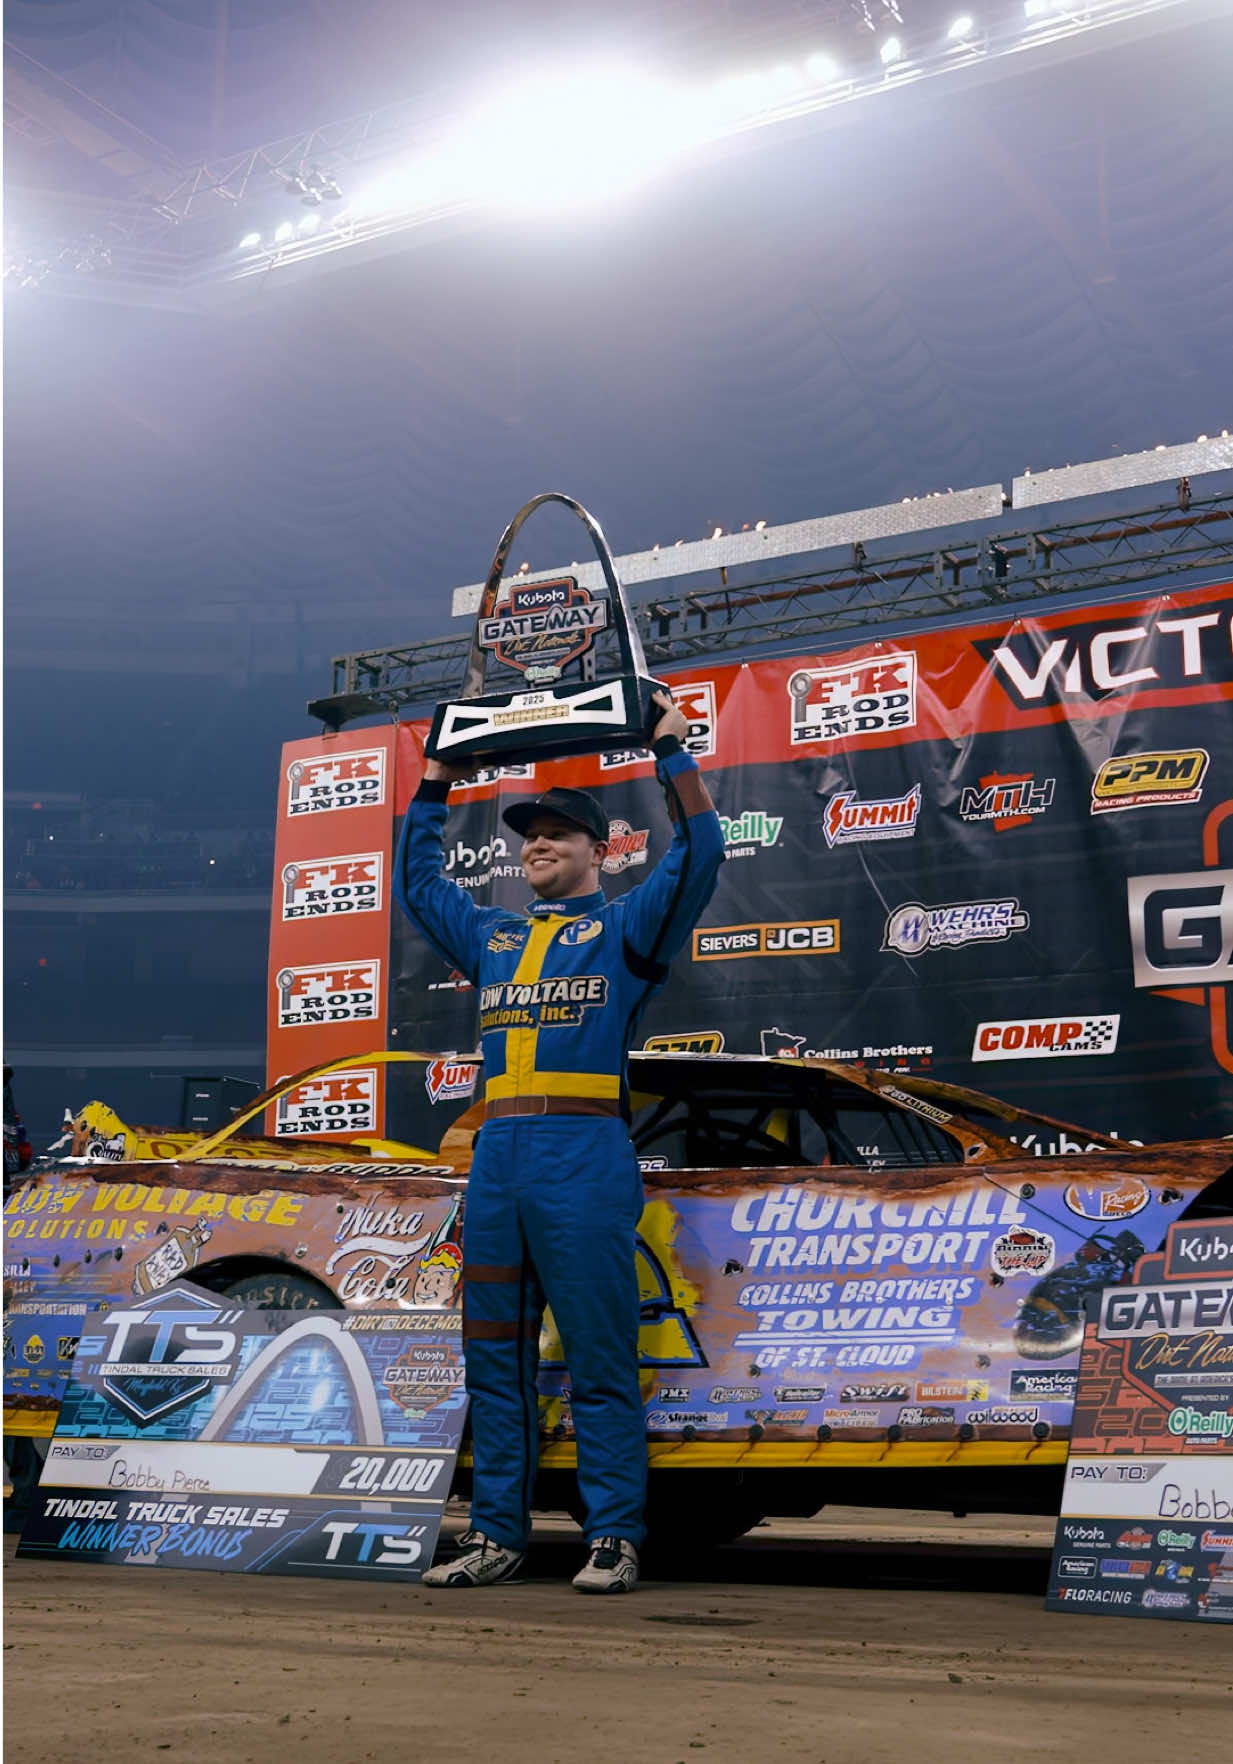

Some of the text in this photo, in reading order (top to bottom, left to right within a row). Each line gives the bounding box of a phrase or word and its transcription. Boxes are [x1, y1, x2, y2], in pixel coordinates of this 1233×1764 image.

[518, 589, 565, 606] Kubota
[483, 606, 600, 641] GATEWAY
[992, 612, 1233, 699] VICT
[811, 661, 909, 705] FK
[494, 705, 569, 727] WINNER
[822, 694, 909, 722] ROD
[793, 710, 909, 742] ENDS
[300, 755, 379, 786] FK
[1103, 758, 1197, 787] PPM
[309, 779, 379, 798] ROD
[960, 779, 1056, 815] MTH
[1094, 795, 1134, 809] RACING
[1136, 791, 1196, 804] PRODUCTS
[290, 792, 379, 815] ENDS
[961, 806, 1046, 822] YOURMTH.COM
[719, 813, 781, 844] Reilly
[293, 860, 376, 890] FK
[305, 884, 376, 902] ROD
[284, 898, 376, 918] ENDS
[931, 904, 1013, 926] WEHRS
[700, 927, 834, 951] SIEVERS JCB
[290, 968, 373, 996] FK
[480, 978, 602, 1011] LOW VOLTAGE
[301, 993, 373, 1009] ROD
[281, 1006, 373, 1025] ENDS
[979, 1022, 1103, 1052] COMP CAMS
[804, 1048, 859, 1060] Collins
[863, 1045, 933, 1058] Brothers
[299, 1103, 370, 1118] ROD
[278, 1116, 370, 1135] ENDS
[93, 1183, 304, 1226] VOLTAGE
[731, 1187, 1027, 1233] CHURCHILL
[335, 1206, 425, 1244] Nuka
[747, 1231, 990, 1268] TRANSPORT
[1180, 1236, 1233, 1263] Kub
[338, 1256, 415, 1305] Cola
[737, 1276, 976, 1306] COLLINS BROTHERS
[756, 1306, 953, 1332] TOWING
[1105, 1288, 1233, 1332] GATE
[104, 1311, 236, 1362] TTS
[755, 1344, 916, 1369] OF ST. CLOUD
[1135, 1333, 1191, 1370] Dirt
[103, 1365, 228, 1377] TINDAL TRUCK SALES
[386, 1367, 464, 1384] GATEWAY
[1025, 1383, 1073, 1398] Racing
[968, 1406, 1038, 1424] wilwood
[53, 1446, 84, 1458] PAY
[109, 1459, 167, 1493] Bobby
[337, 1456, 442, 1496] 20,000
[1071, 1466, 1147, 1480] PAY TO:
[46, 1498, 289, 1529] TINDAL TRUCK SALES
[1158, 1483, 1233, 1520] Bobb
[60, 1521, 252, 1561] WINNER BONUS
[321, 1522, 422, 1566] TTS
[1064, 1526, 1104, 1540] Kubota
[1064, 1588, 1133, 1605] FLORACING
